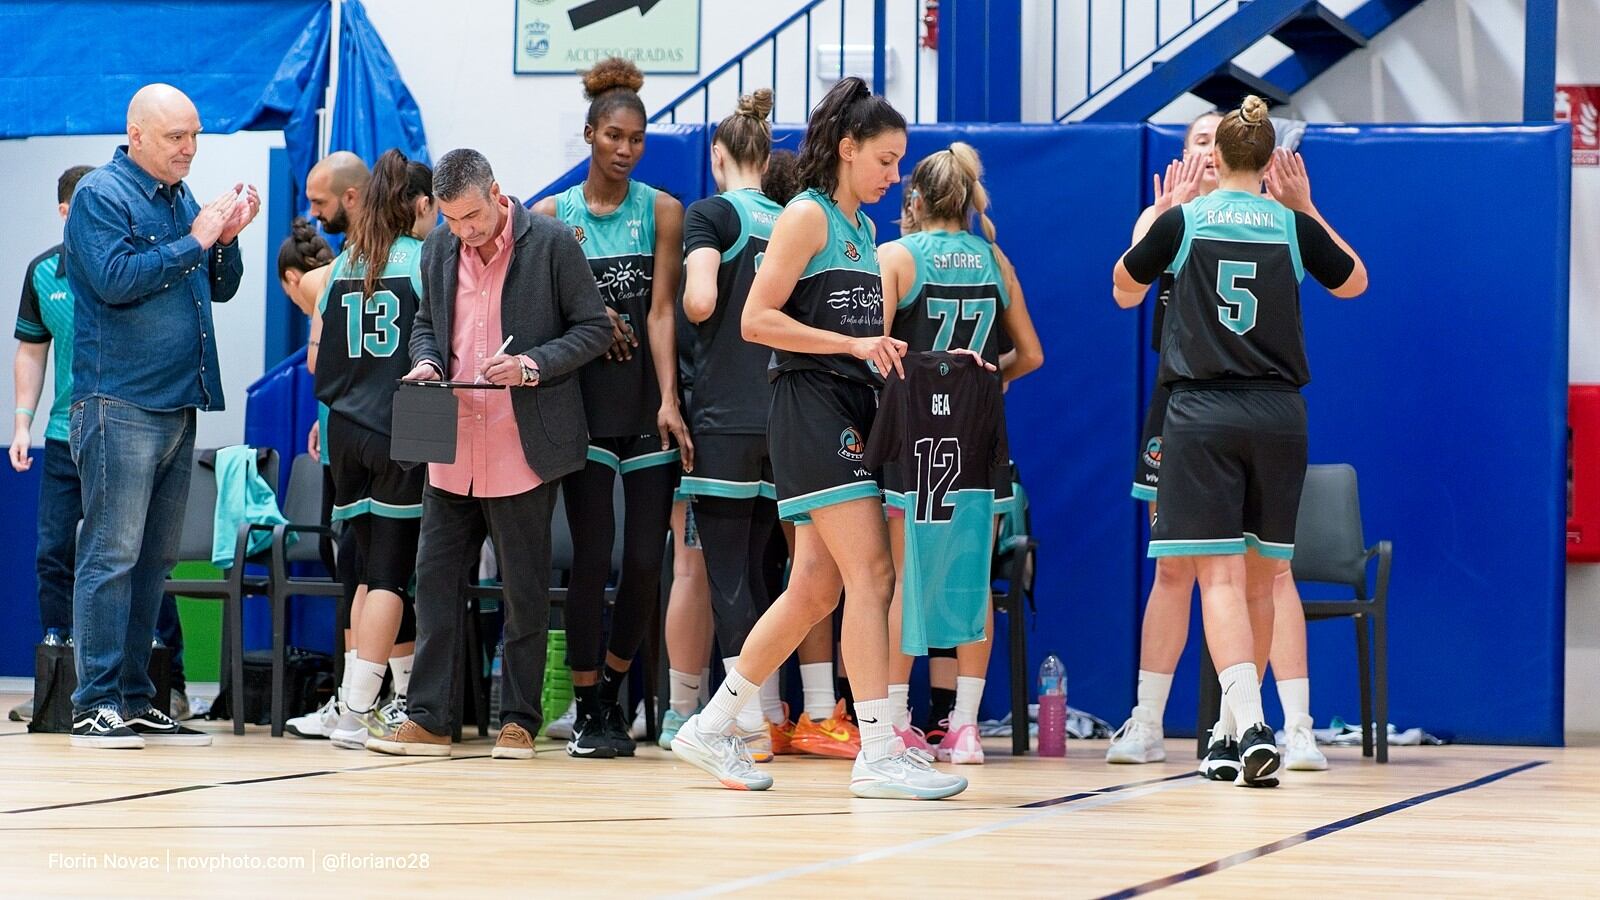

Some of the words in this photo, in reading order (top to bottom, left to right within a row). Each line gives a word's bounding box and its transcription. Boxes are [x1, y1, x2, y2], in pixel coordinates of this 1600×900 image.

[624, 47, 685, 62] GRADAS
[1207, 210, 1274, 228] RAKSANYI
[933, 252, 983, 270] SATORRE
[1216, 259, 1258, 336] 5
[341, 289, 400, 358] 13
[926, 297, 997, 357] 77
[931, 393, 951, 416] GEA
[914, 437, 961, 523] 12
